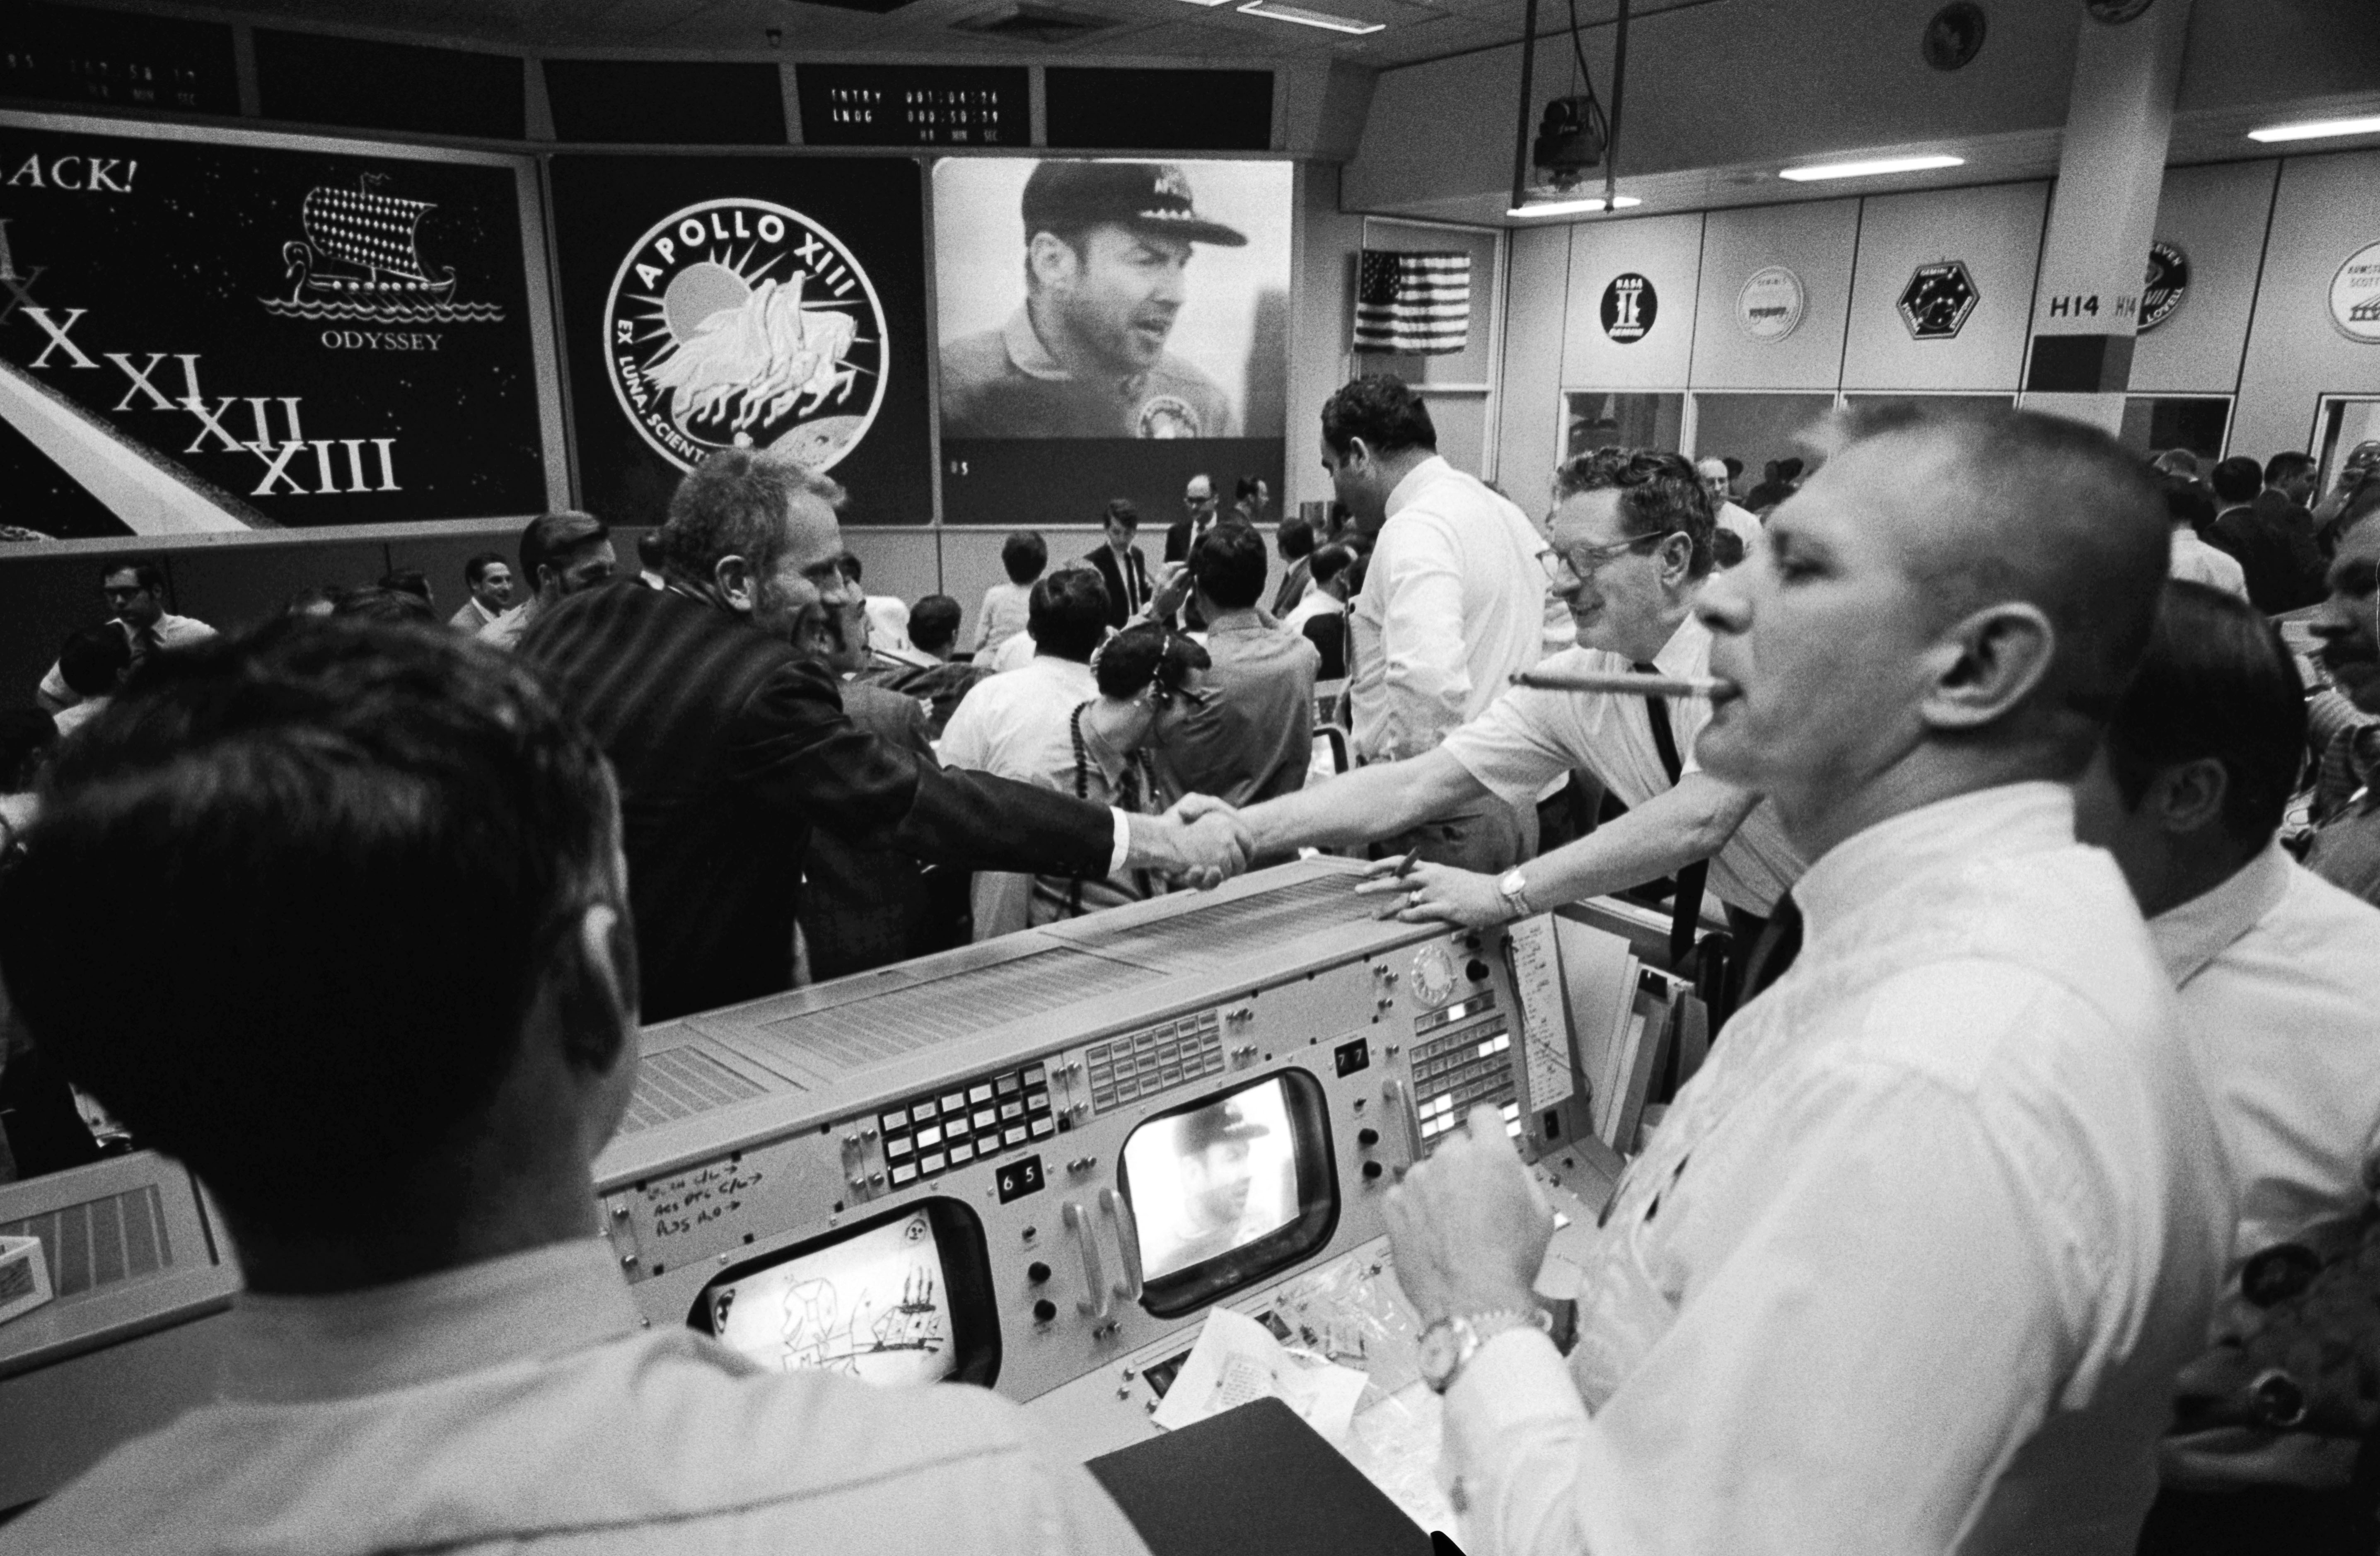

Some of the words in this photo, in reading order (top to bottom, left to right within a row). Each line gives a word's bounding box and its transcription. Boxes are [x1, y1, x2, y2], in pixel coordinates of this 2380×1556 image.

[0, 154, 138, 193] ACK!
[635, 211, 785, 290] APOLLO
[793, 232, 855, 297] XIII
[2153, 243, 2183, 267] EVEN
[1615, 278, 1643, 289] NASA
[2050, 295, 2099, 317] H14
[2115, 297, 2136, 316] H14
[2146, 287, 2184, 323] LOVELL
[19, 307, 101, 368] X
[321, 331, 443, 351] ODYSSEY
[618, 319, 633, 344] EX
[103, 353, 216, 412] XI
[176, 396, 308, 453] XII
[241, 438, 402, 495] XIII
